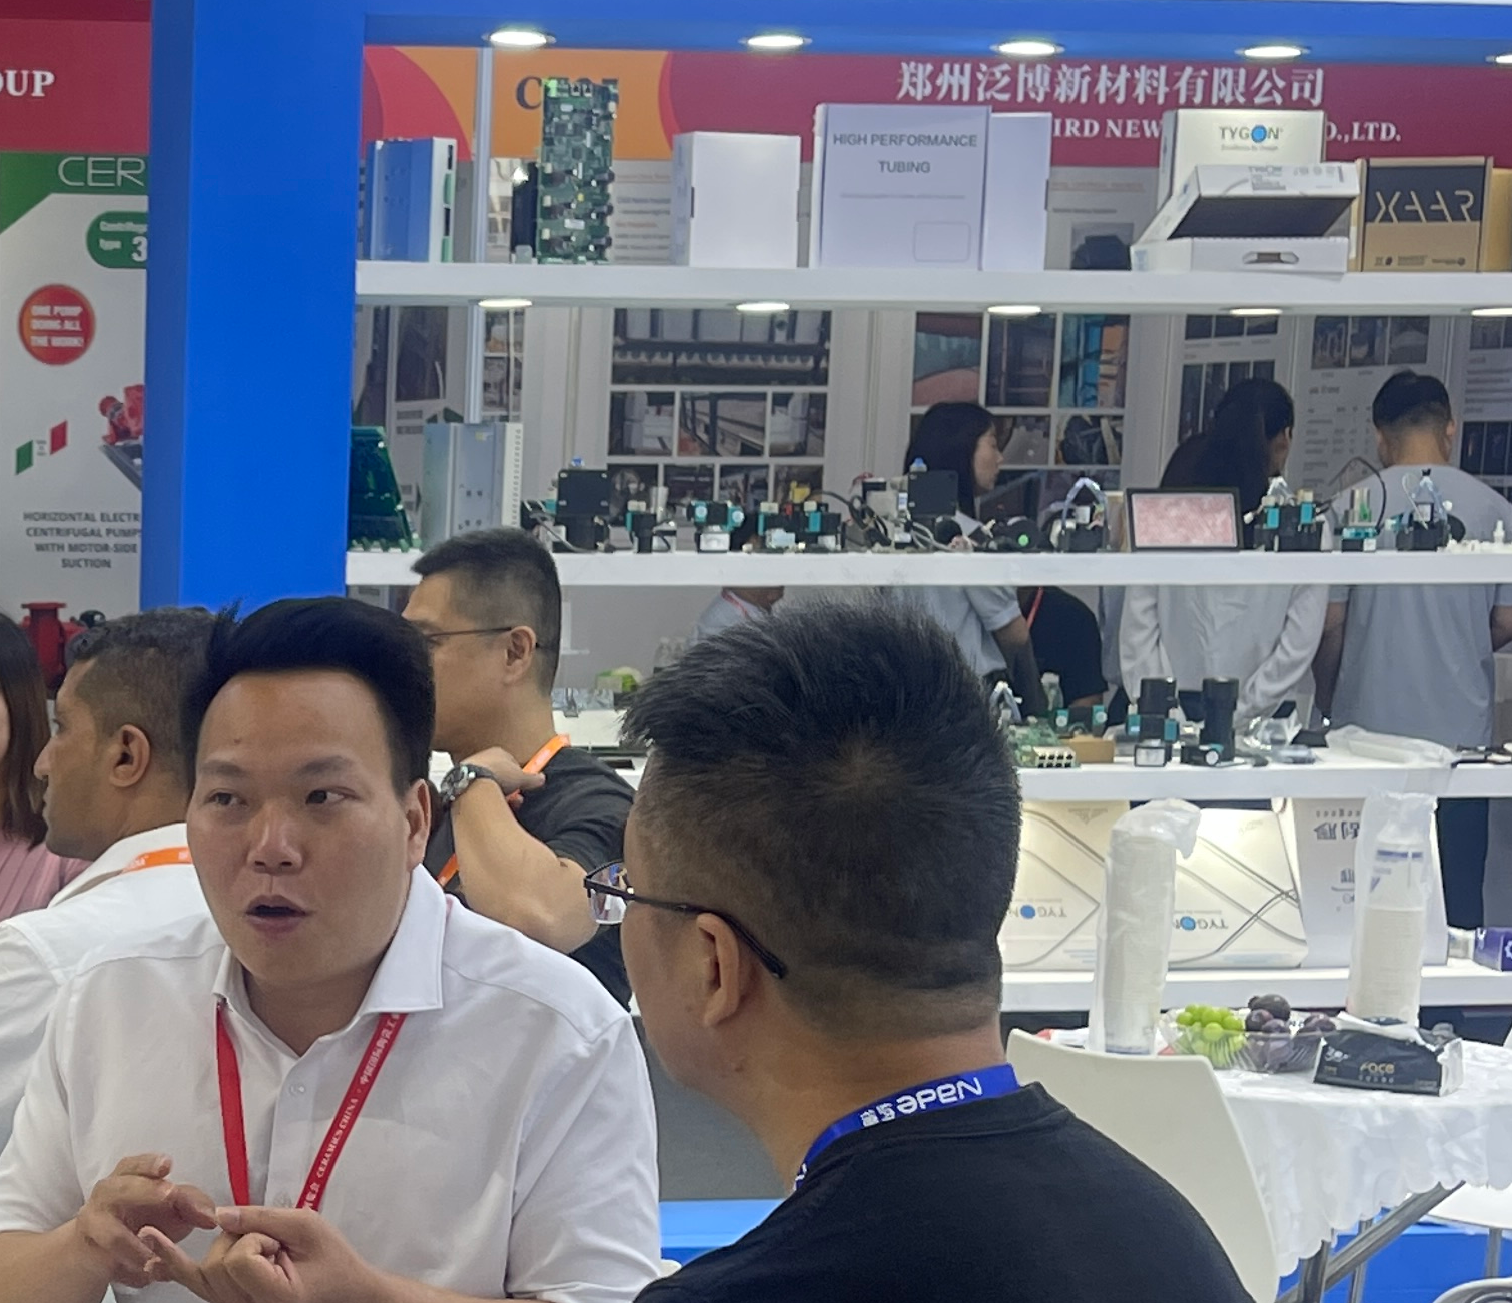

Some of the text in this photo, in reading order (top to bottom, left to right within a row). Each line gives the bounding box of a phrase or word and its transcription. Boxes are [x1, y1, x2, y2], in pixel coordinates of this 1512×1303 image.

[897, 60, 1326, 107] 郑州泛博新材料有限公司
[833, 133, 978, 147] HIGH PERFORMANCE
[57, 156, 146, 188] CER
[877, 161, 931, 173] TUBING
